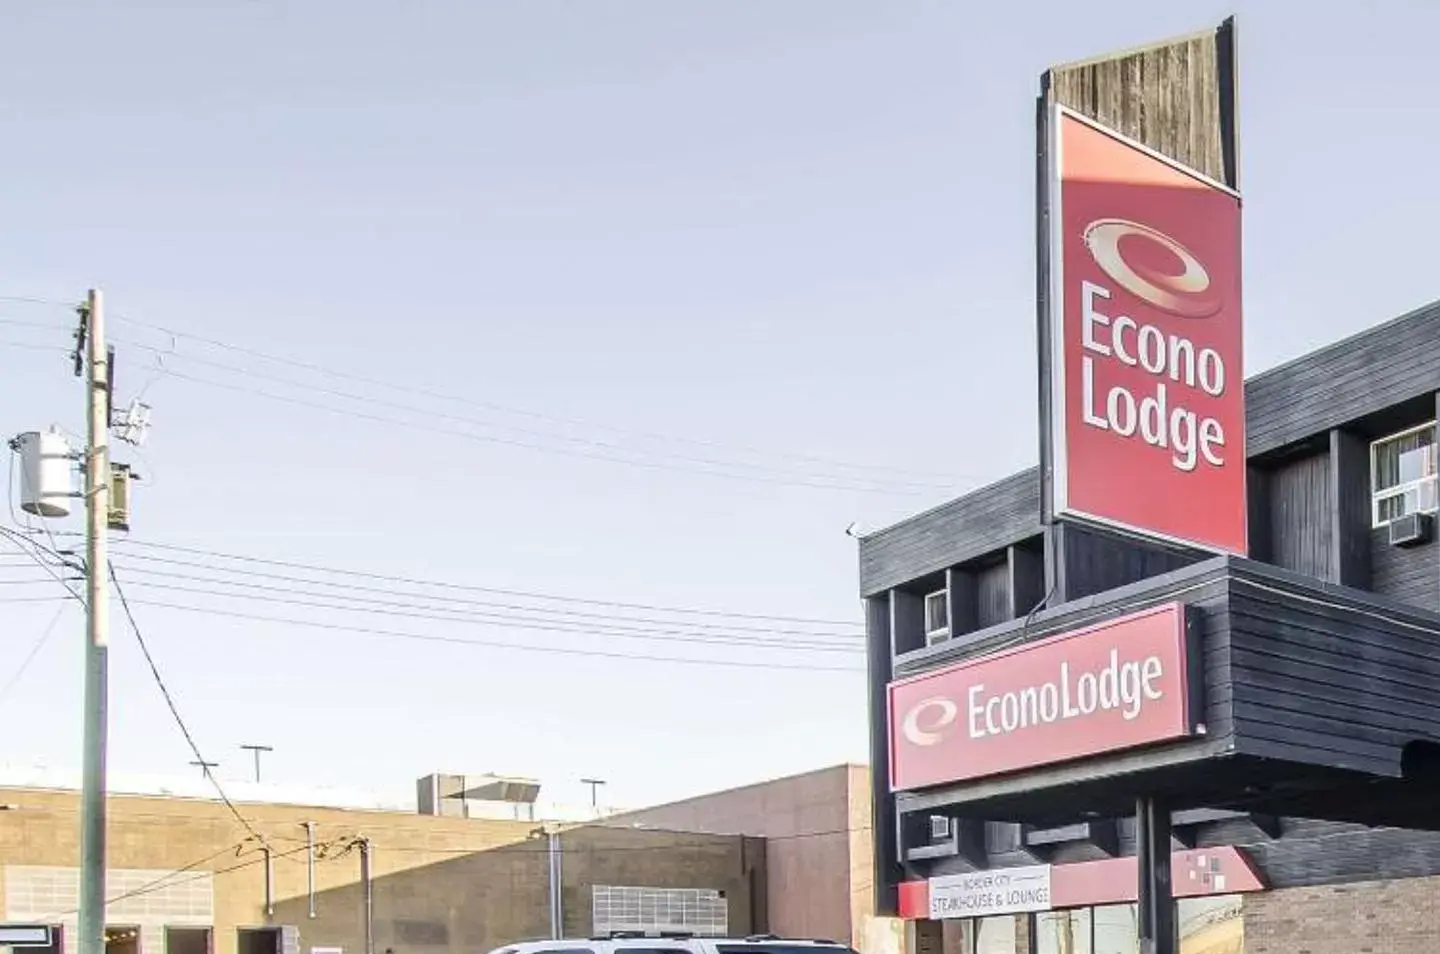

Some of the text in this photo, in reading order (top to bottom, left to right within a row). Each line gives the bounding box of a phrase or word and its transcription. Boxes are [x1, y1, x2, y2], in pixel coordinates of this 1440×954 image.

[1082, 280, 1225, 396] Econo
[1082, 356, 1225, 472] Lodge
[967, 648, 1163, 738] EconoLodge
[932, 887, 1049, 912] STEAKHOUSE & LOUNGE
